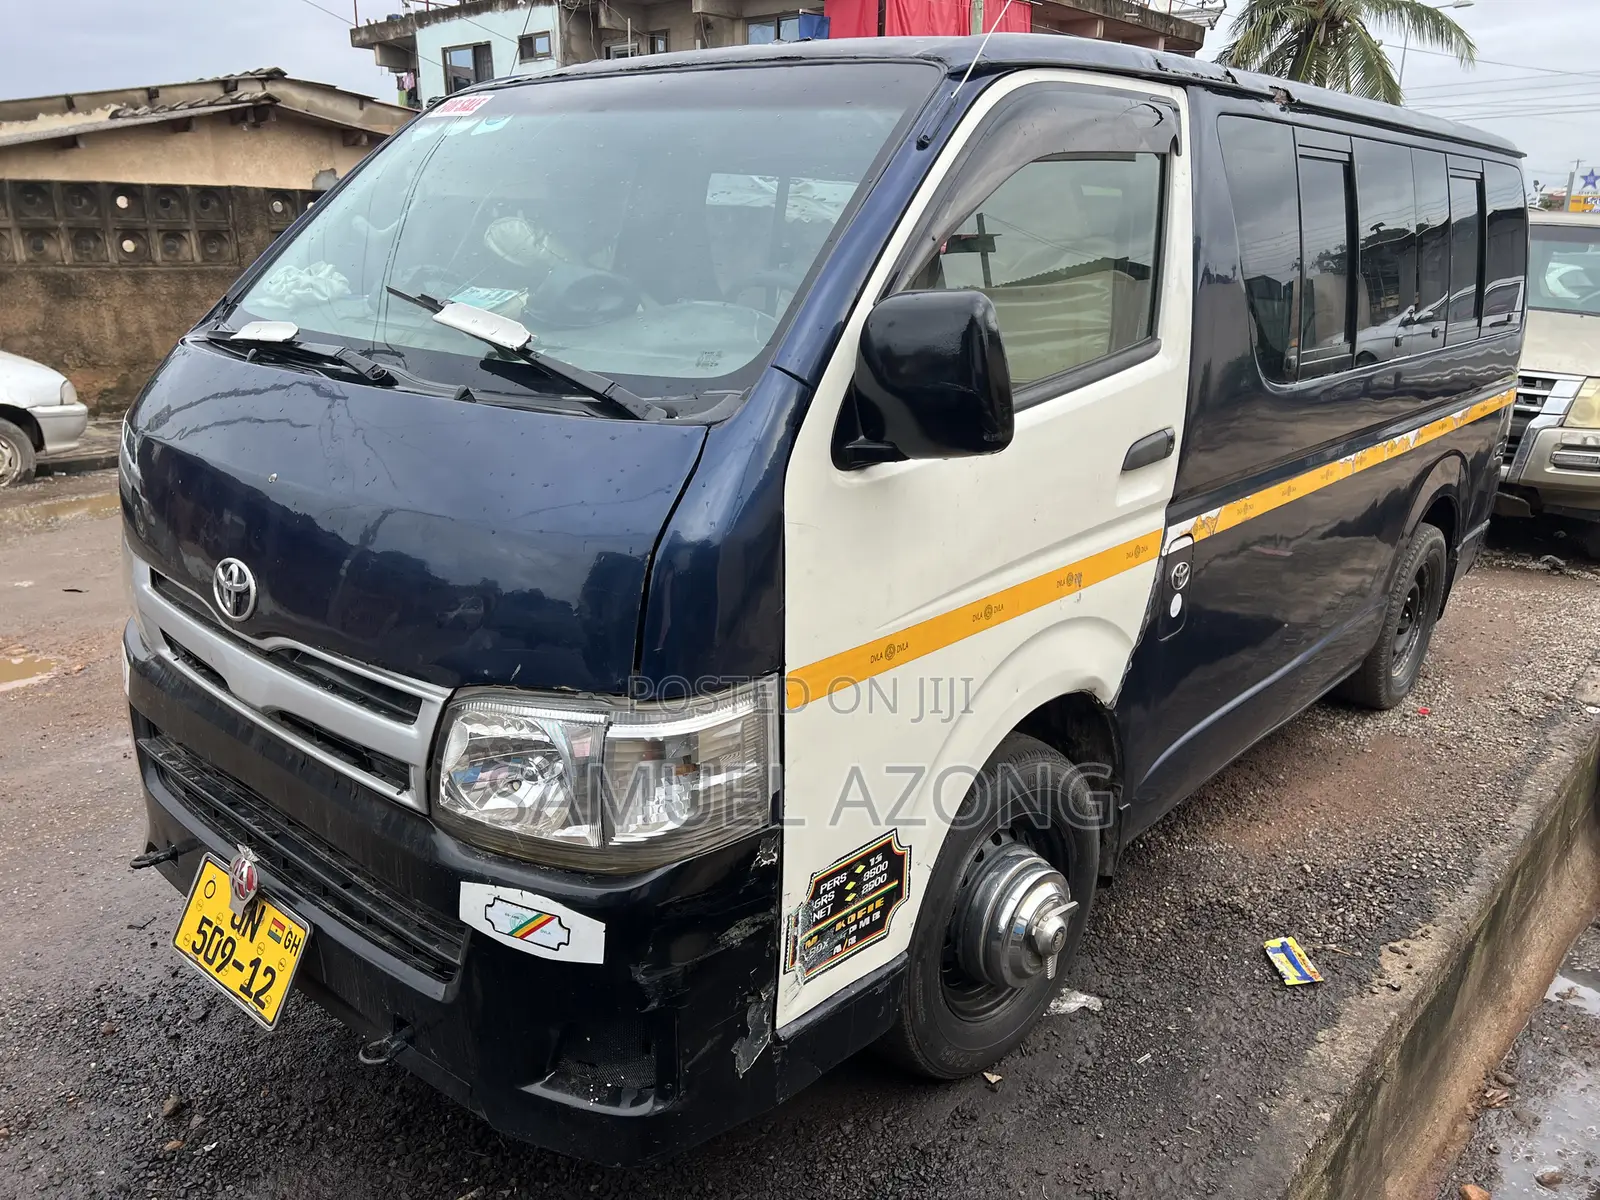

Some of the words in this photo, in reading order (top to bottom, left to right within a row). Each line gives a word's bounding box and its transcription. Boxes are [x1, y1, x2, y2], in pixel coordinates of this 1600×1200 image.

[870, 651, 883, 664] DVLA
[896, 640, 909, 653] DVLA
[820, 872, 848, 895] PERS
[869, 852, 883, 867] 15
[812, 903, 834, 923] NET
[861, 872, 888, 896] 2500
[813, 890, 835, 909] GRS
[835, 897, 884, 932] KOFIE
[284, 930, 302, 957] GH
[191, 915, 277, 1010] 509-12
